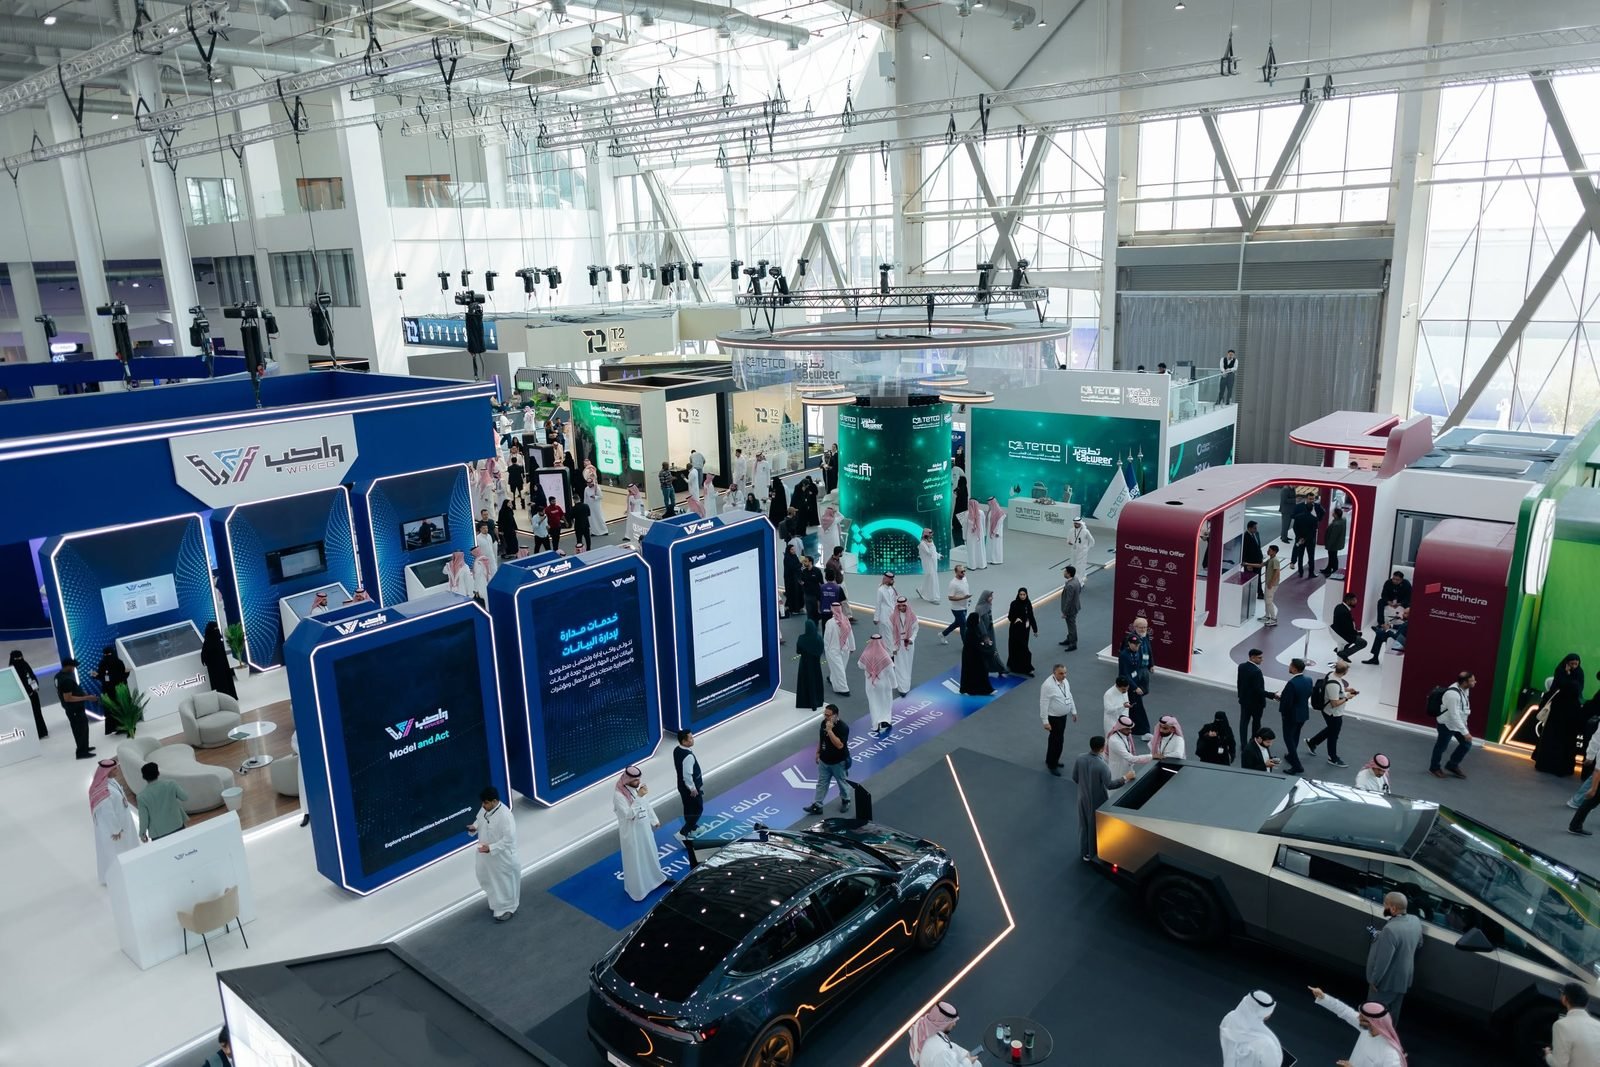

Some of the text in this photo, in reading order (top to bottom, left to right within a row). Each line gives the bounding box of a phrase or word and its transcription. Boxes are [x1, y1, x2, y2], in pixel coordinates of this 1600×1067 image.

[611, 328, 625, 339] T2
[691, 408, 700, 418] T2
[770, 408, 779, 417] T2
[264, 436, 344, 473] واكب
[1076, 454, 1112, 464] tatweer
[287, 461, 336, 475] WAKEB
[1124, 543, 1185, 558] Capabilities We Offer
[1442, 586, 1463, 595] TECH
[1441, 593, 1488, 606] mahindra
[1430, 608, 1448, 616] Scale
[560, 612, 619, 642] خدمات مدارة
[562, 628, 619, 656] لإدارة البيانات
[901, 700, 933, 716] صالة
[851, 733, 905, 763] PRIVATE
[898, 710, 944, 735] DINING
[389, 730, 450, 760] Model and Act
[732, 792, 772, 813] صالة
[718, 806, 780, 840] DINING
[385, 838, 402, 848] Explore
